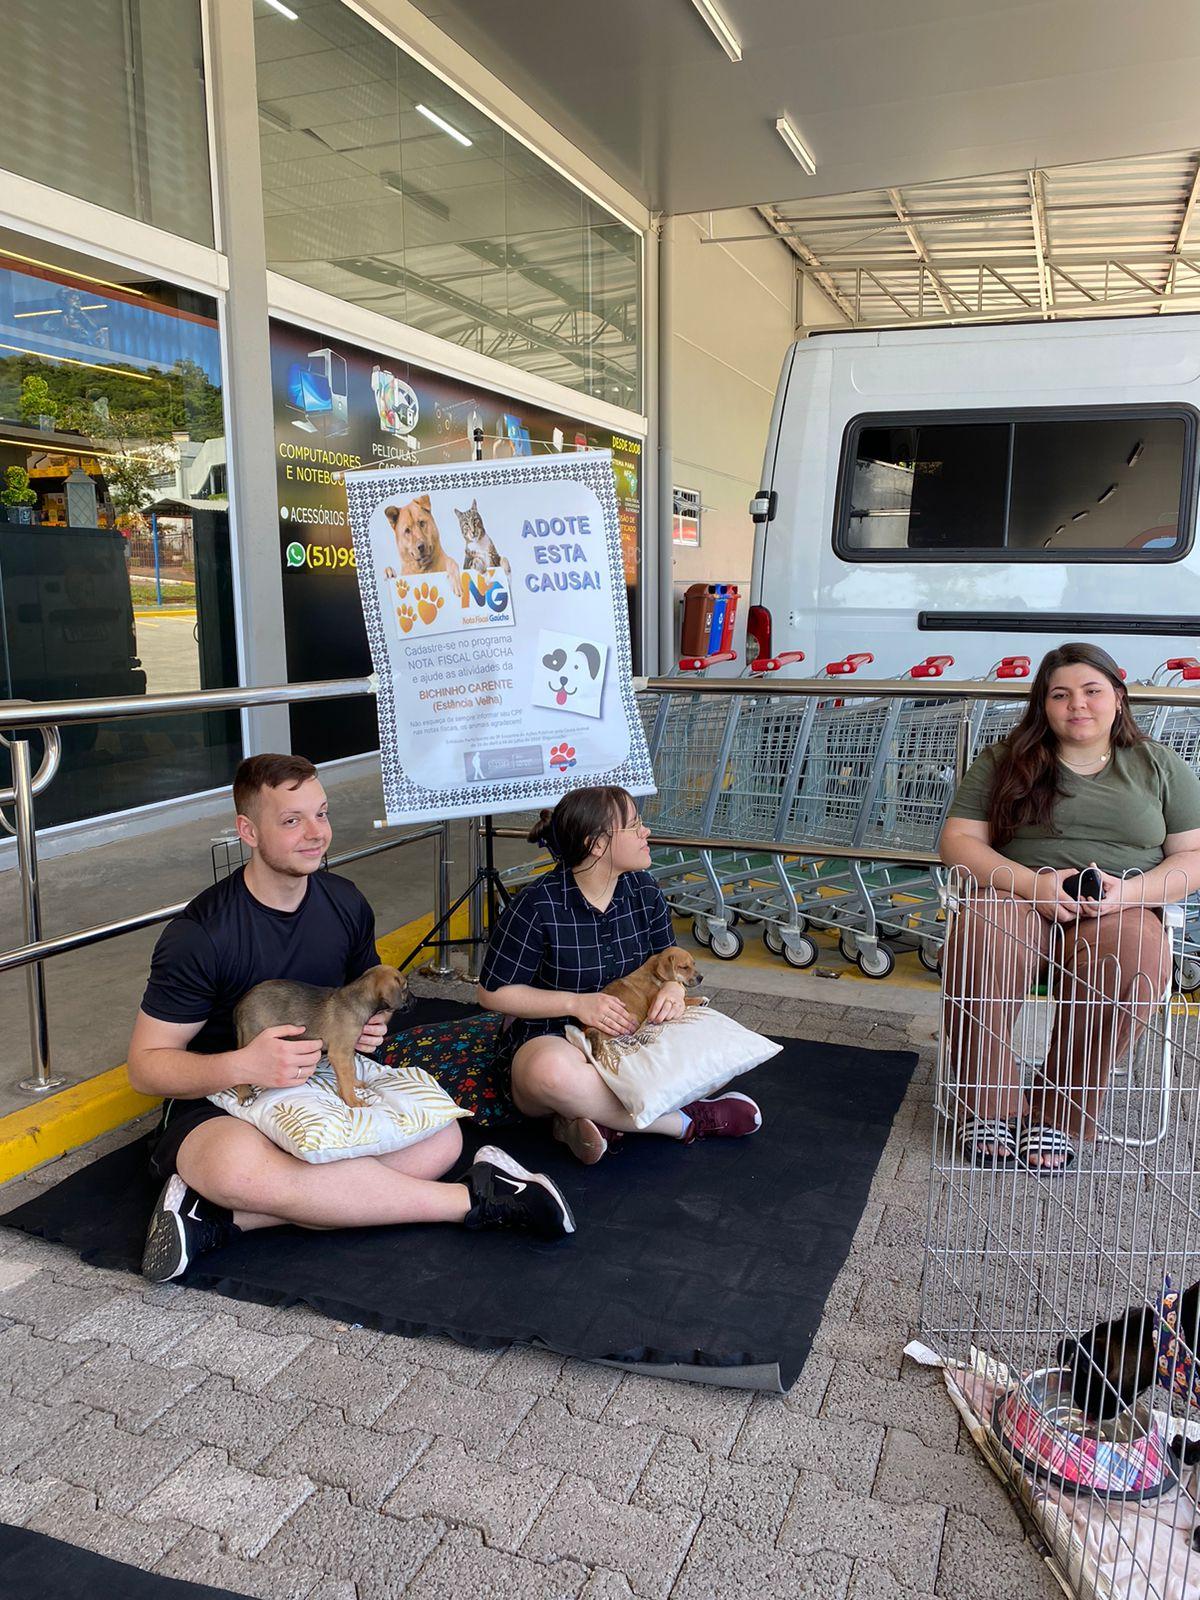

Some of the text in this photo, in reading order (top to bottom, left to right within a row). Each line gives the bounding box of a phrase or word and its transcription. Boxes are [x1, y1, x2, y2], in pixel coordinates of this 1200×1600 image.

[612, 435, 628, 451] DESDE
[279, 443, 361, 468] COMPUTADORES
[286, 465, 293, 479] E
[290, 505, 344, 526] ACESSÓRIOS
[521, 516, 591, 538] ADOTE
[534, 544, 587, 564] ESTA
[525, 571, 601, 593] CAUSA!
[404, 635, 512, 657] Cadastre-se no programa
[408, 658, 434, 670] NOTA
[437, 652, 471, 666] FISCAL
[412, 661, 513, 684] e ajude as atividades da
[419, 679, 513, 700] BICHINHO CARENTE
[432, 694, 502, 713] (Estância Velha)
